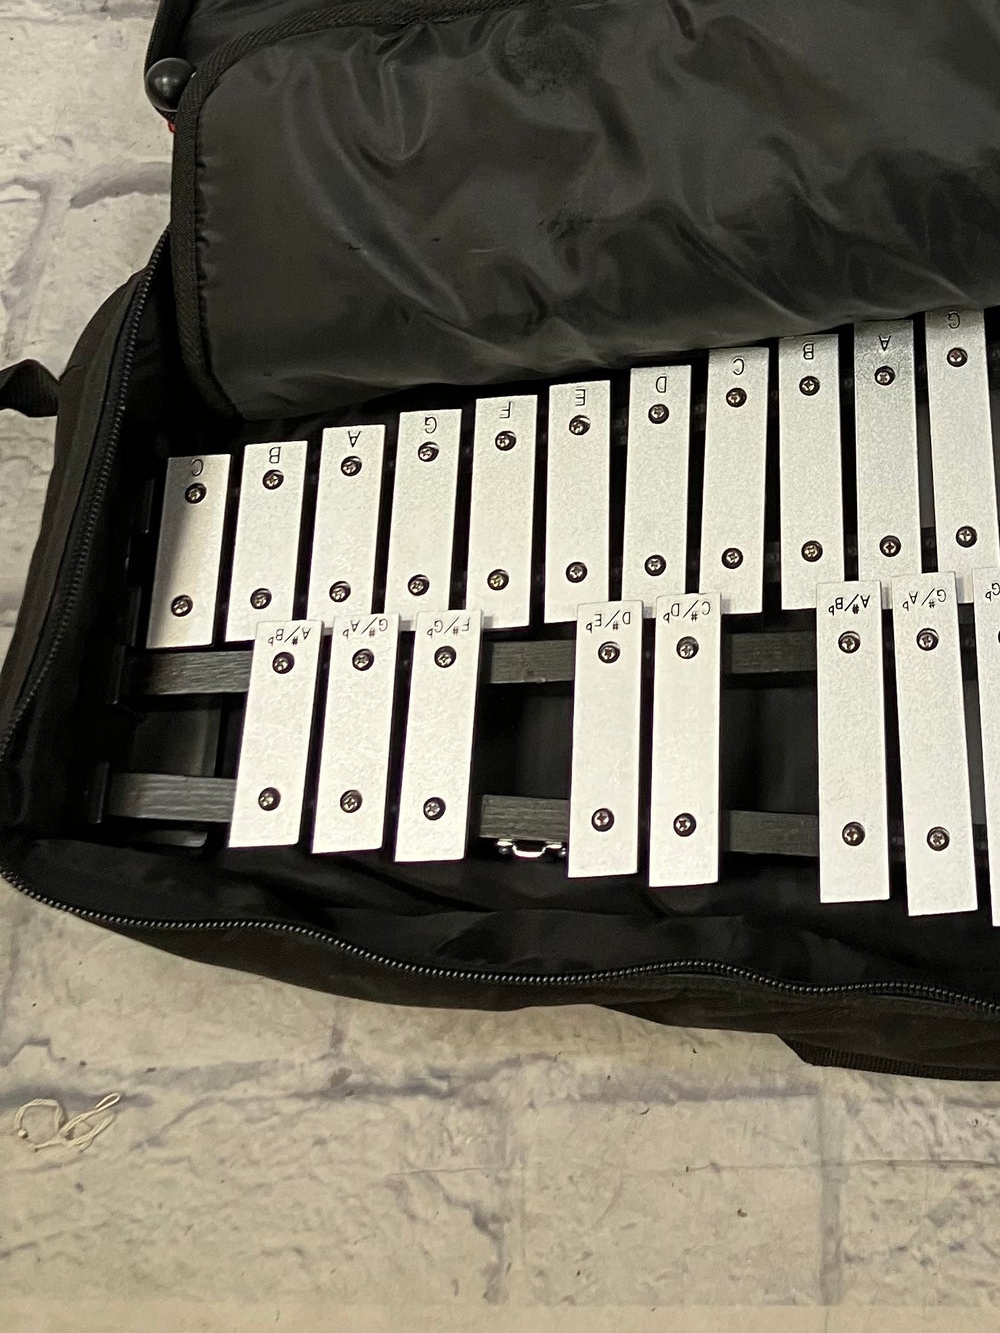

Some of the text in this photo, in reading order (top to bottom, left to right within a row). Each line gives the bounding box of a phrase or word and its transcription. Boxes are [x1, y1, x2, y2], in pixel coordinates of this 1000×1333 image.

[947, 312, 961, 329] G
[802, 343, 815, 360] B
[878, 335, 892, 352] A
[733, 358, 745, 375] C
[655, 376, 667, 393] D
[575, 388, 586, 406] E
[499, 401, 513, 419] F
[424, 416, 437, 433] G
[347, 430, 362, 448] A
[268, 446, 281, 463] B
[191, 458, 204, 476] C
